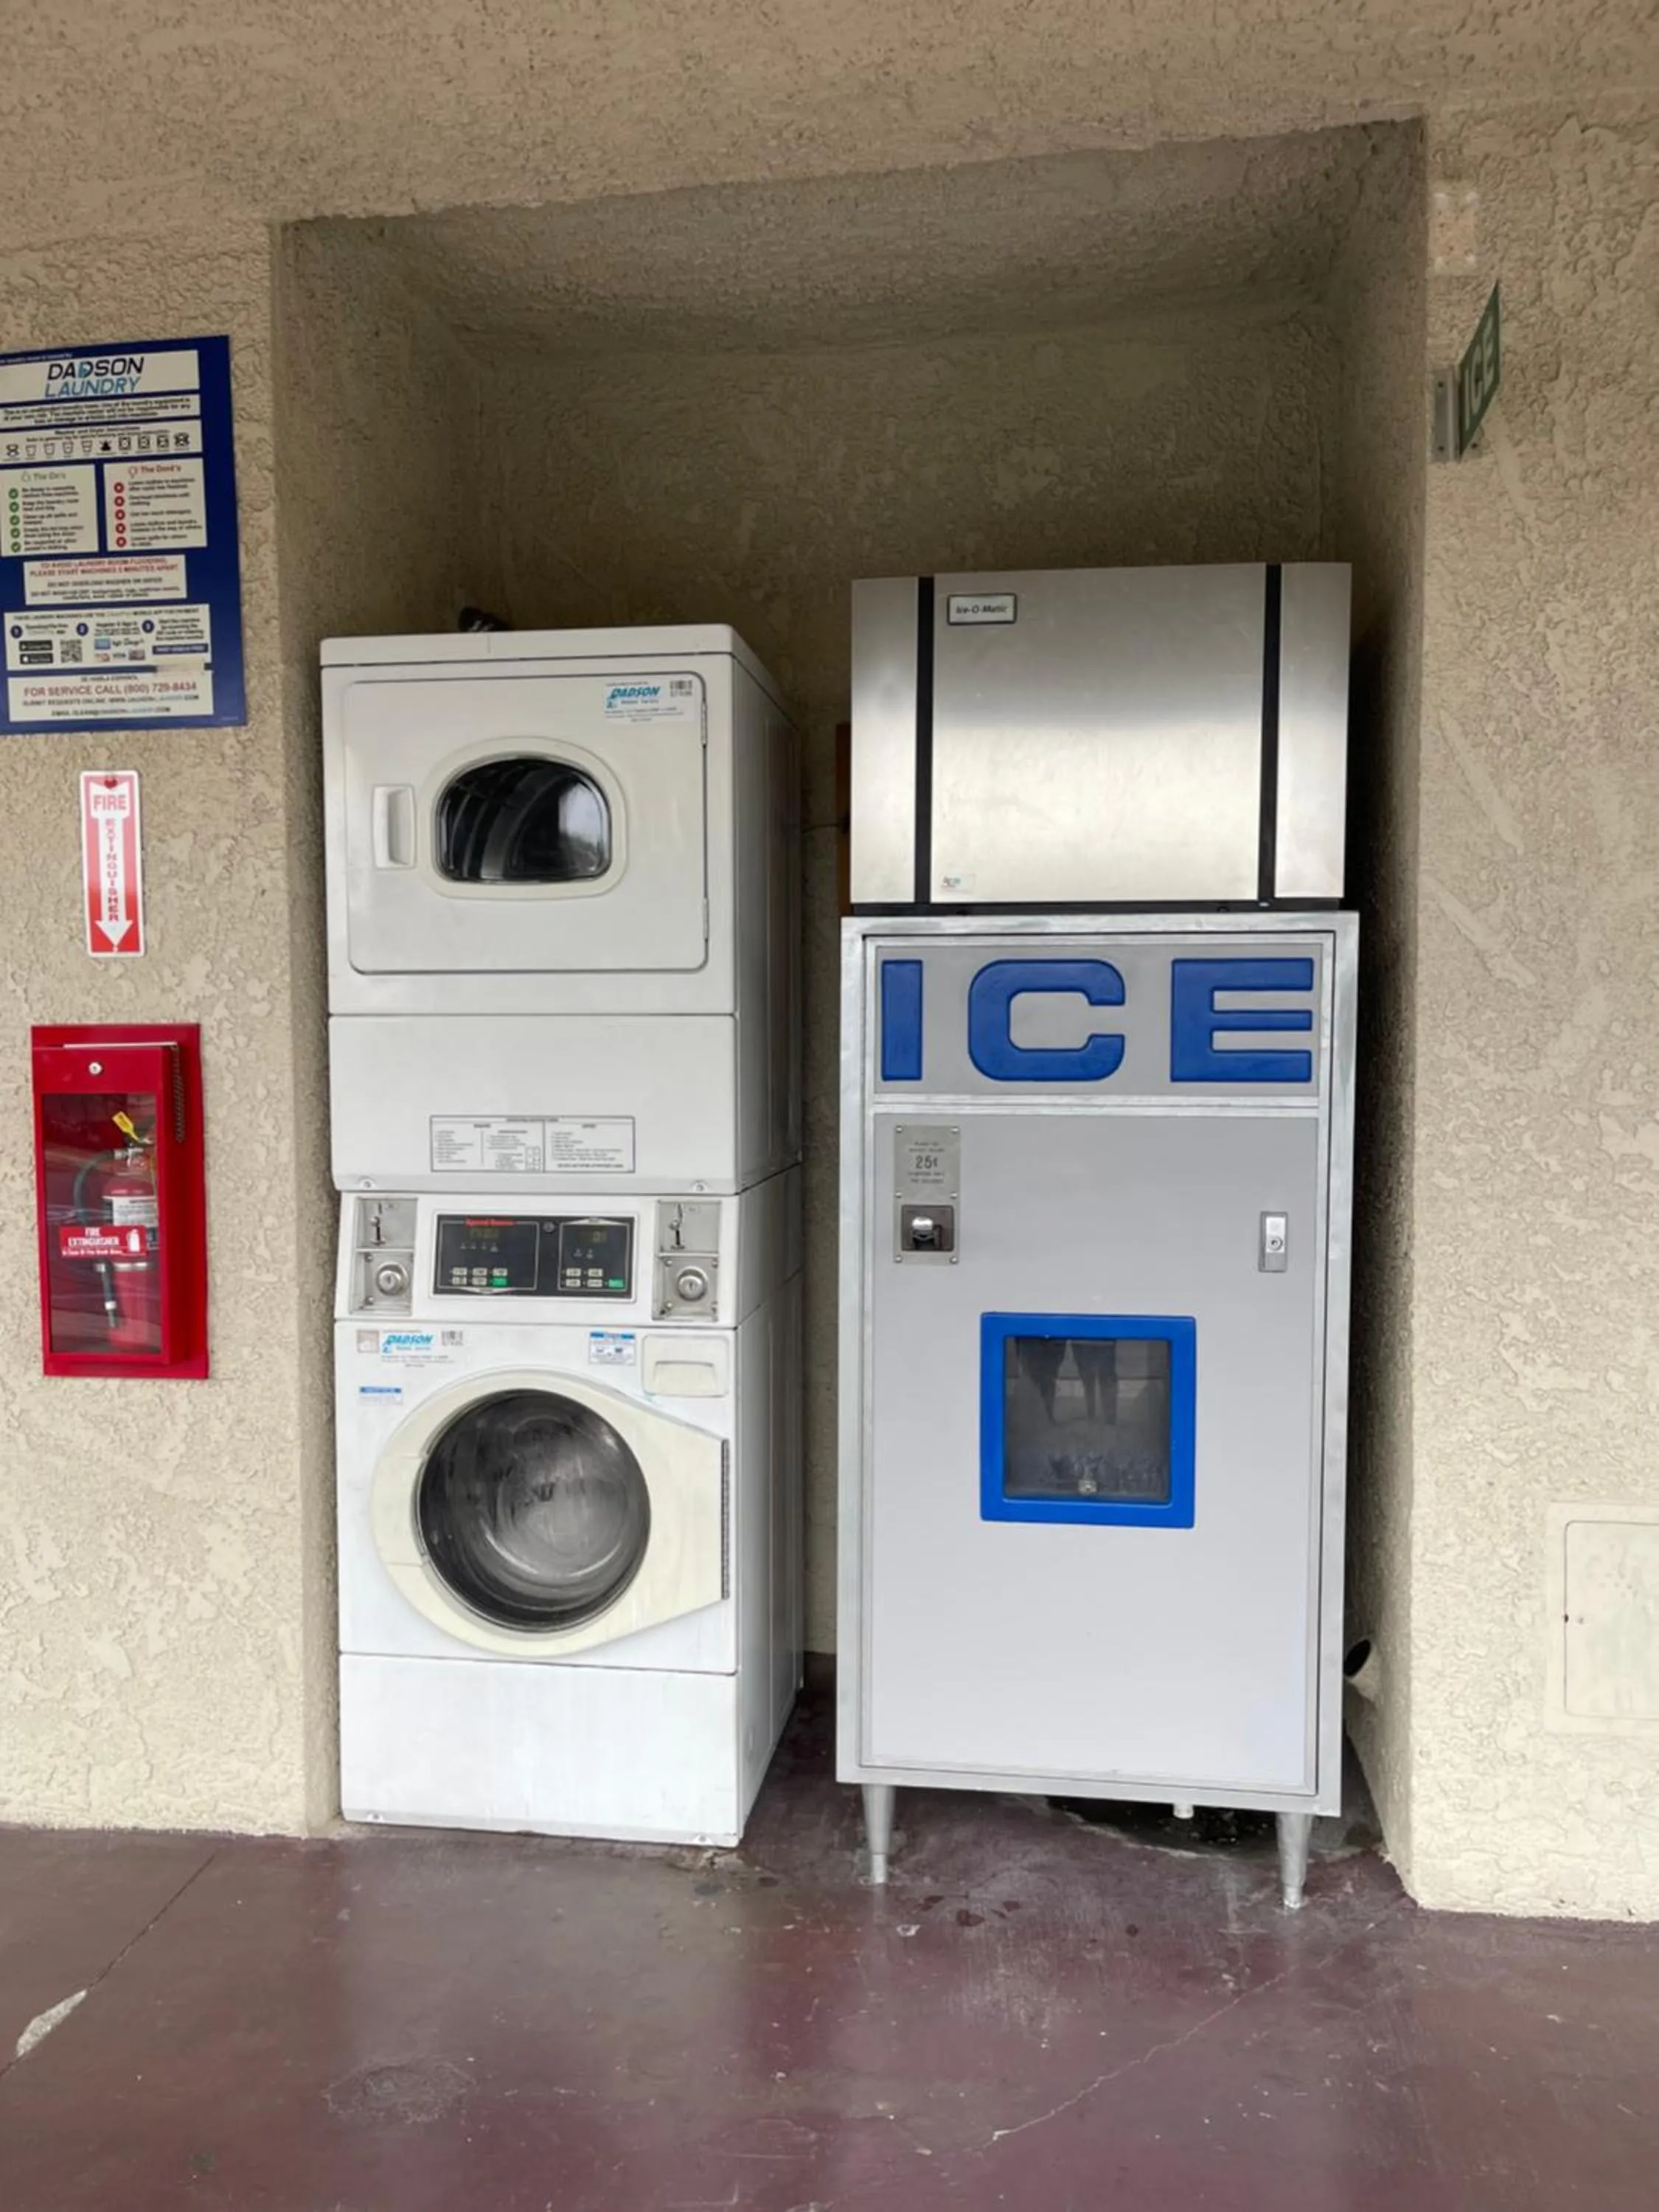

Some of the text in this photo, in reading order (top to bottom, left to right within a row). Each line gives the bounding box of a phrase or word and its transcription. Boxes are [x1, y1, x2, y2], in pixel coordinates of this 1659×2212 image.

[47, 357, 145, 380] DADSON
[44, 377, 141, 399] LAUNDRY
[24, 686, 46, 697] FOR
[48, 684, 91, 696] SERVICE
[95, 684, 122, 695] CALL
[93, 794, 127, 811] FIRE
[105, 818, 119, 922] EXTINGUISHER
[881, 959, 1313, 1082] ICE
